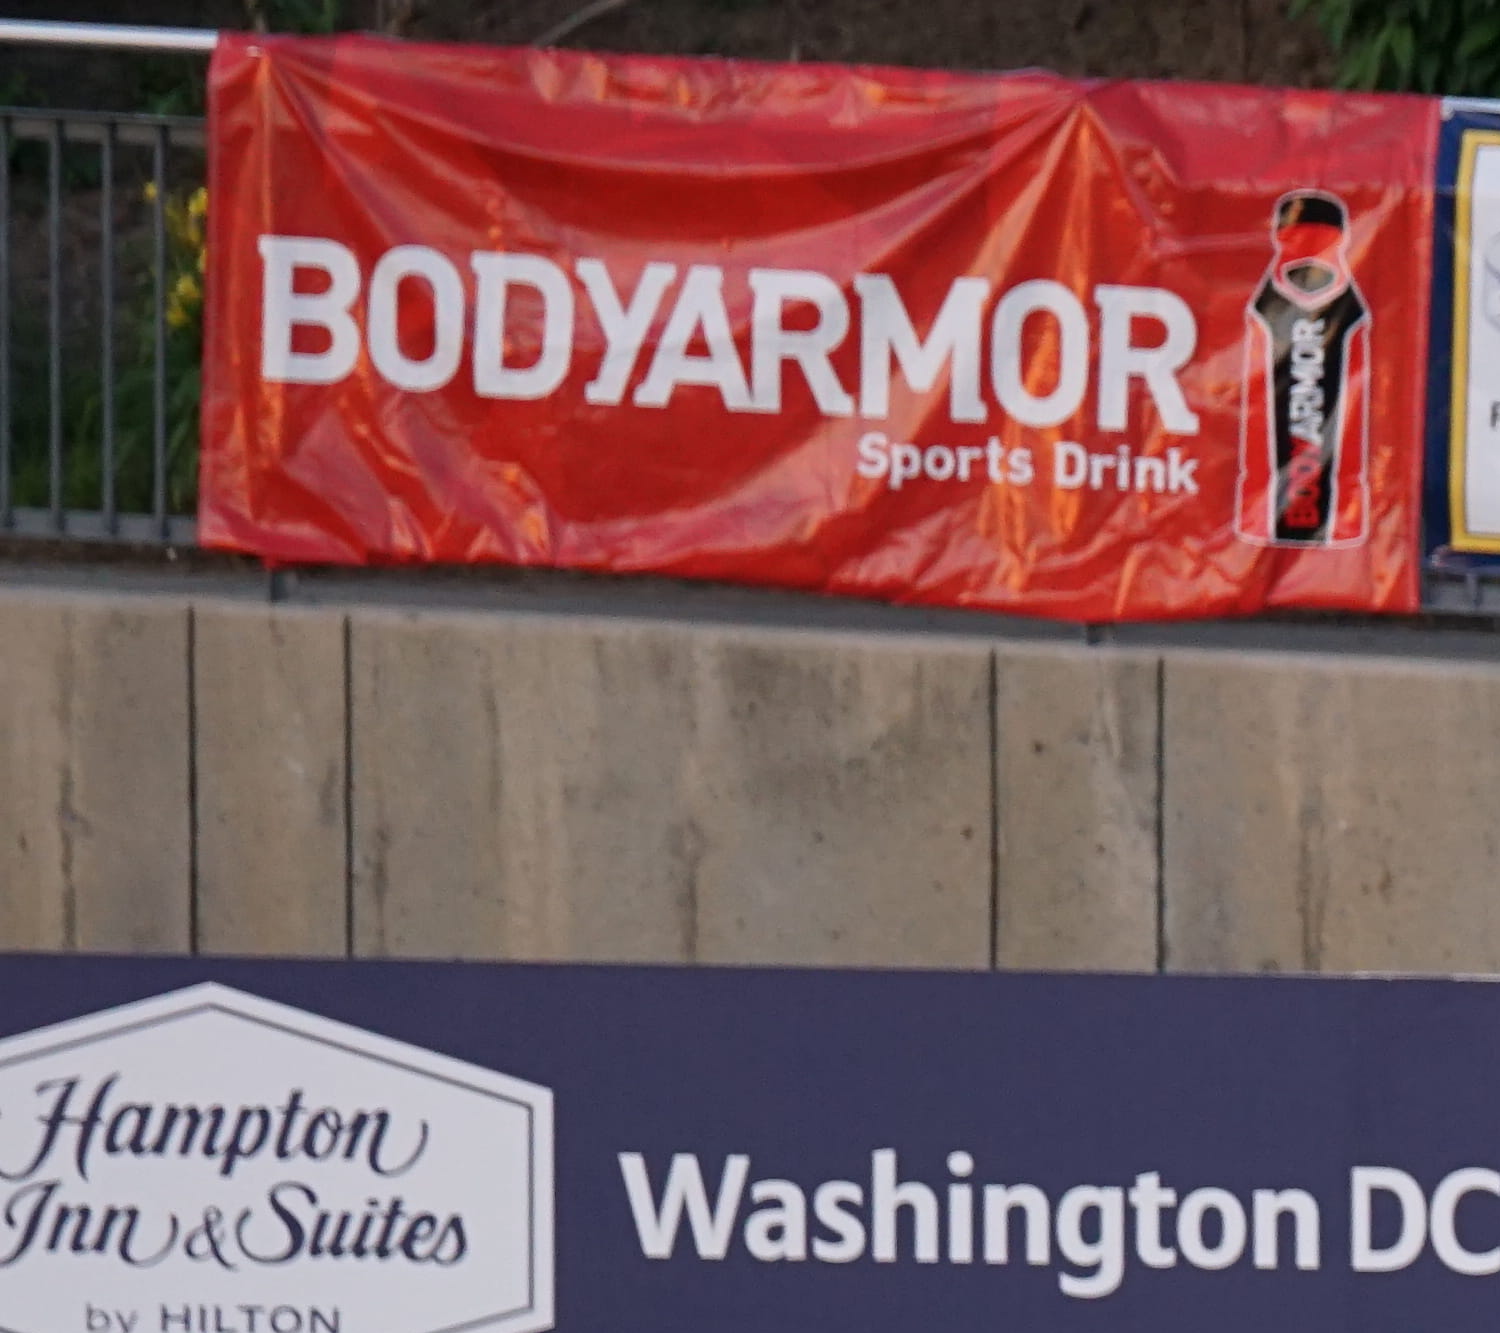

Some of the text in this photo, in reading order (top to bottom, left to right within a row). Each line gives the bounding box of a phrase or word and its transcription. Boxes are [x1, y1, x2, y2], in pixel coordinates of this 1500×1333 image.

[259, 236, 1198, 432] BODYARMOR
[857, 430, 1199, 494] Sports Drink
[0, 1071, 428, 1182] Hampton
[0, 1181, 468, 1269] Inn & Suites
[618, 1148, 1322, 1300] Washington
